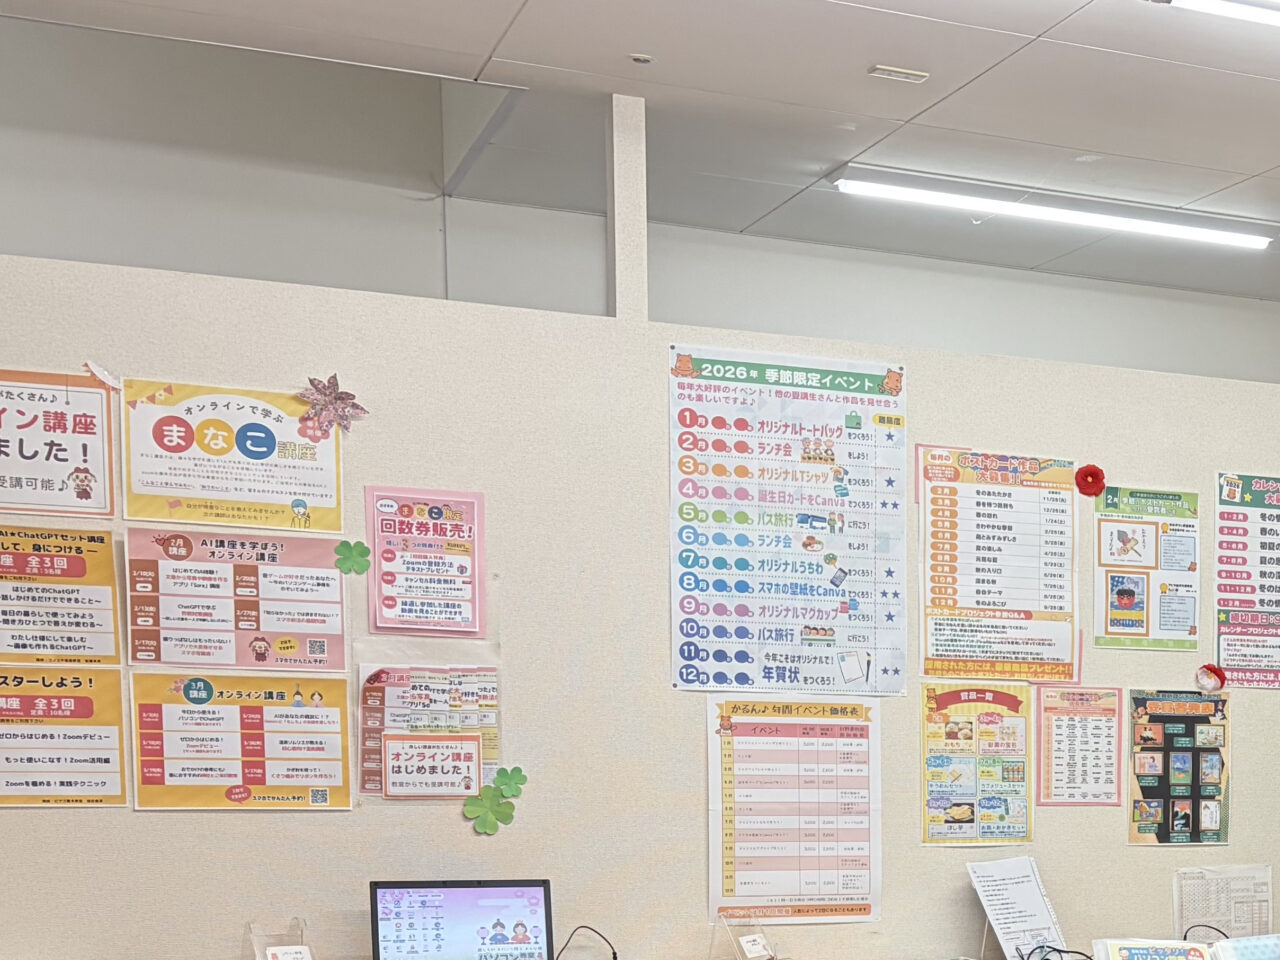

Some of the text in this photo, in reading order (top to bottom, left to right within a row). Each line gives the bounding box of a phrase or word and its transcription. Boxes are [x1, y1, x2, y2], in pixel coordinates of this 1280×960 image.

[701, 363, 873, 391] 2026年 季節限定イベント
[184, 401, 283, 424] オンラインで学ぶ
[878, 416, 901, 426] 難易度
[757, 420, 843, 439] オリジナルトートバッグ
[758, 442, 792, 457] ランチ会
[960, 456, 1039, 472] ポストカード作品
[757, 467, 829, 484] オリジナルTシャツ
[758, 489, 845, 508] 誕生日カードをCanva
[757, 511, 794, 523] バス旅行
[758, 534, 792, 548] ランチ会
[208, 550, 278, 563] オンライン講座
[757, 560, 823, 575] オリジナルうちわ
[758, 582, 846, 598] スマホの壁紙をCanva
[758, 606, 839, 621] オリジナルマグカップ
[757, 628, 794, 643] バス旅行
[762, 666, 800, 684] 年賀状
[191, 682, 204, 691] 3月
[189, 690, 208, 699] 講座
[217, 690, 286, 701] オンライン講座
[752, 727, 782, 735] イベント
[391, 752, 474, 763] オンライン講座
